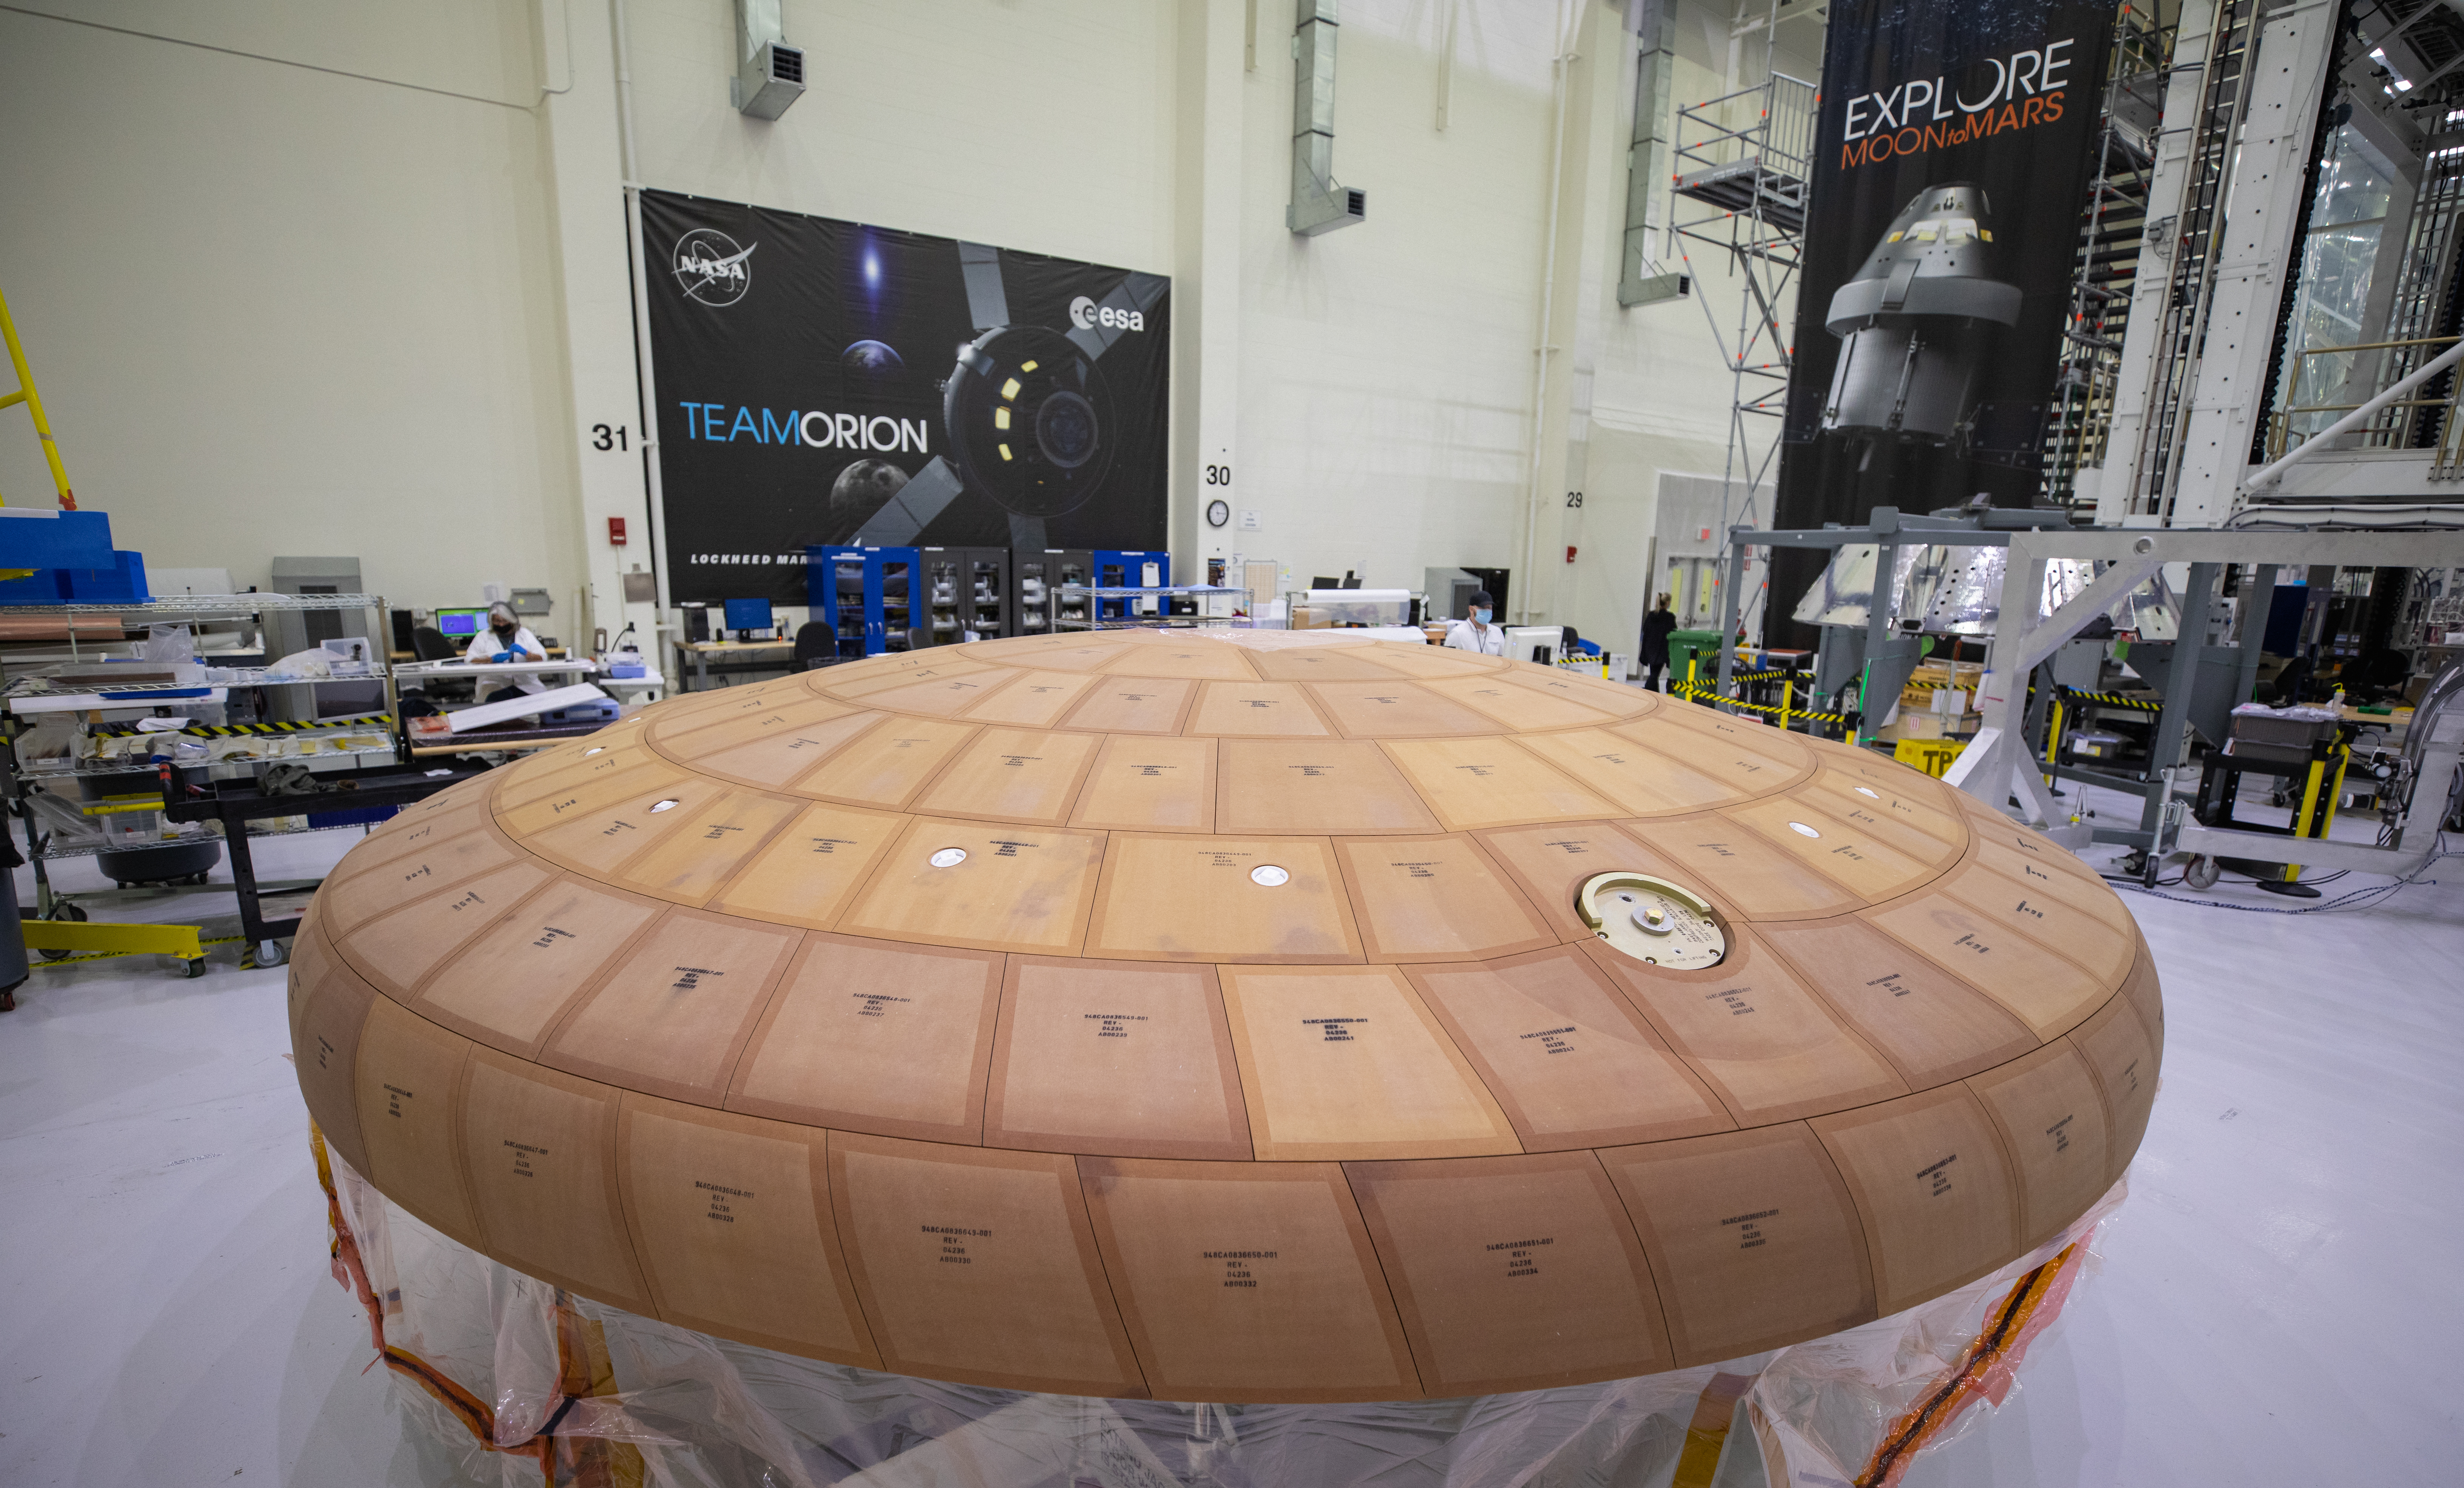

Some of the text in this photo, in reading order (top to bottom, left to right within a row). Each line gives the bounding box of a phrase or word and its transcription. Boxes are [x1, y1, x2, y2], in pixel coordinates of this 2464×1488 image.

[1844, 38, 2074, 141] EXPLORE
[681, 255, 746, 280] NASA
[1099, 306, 1144, 332] esa
[591, 423, 628, 451] 31
[1206, 465, 1230, 486] 30
[1567, 492, 1582, 508] 29
[690, 554, 808, 565] LOCKHEED MAR
[1923, 749, 1960, 777] TP
[1657, 901, 1677, 920] HEATSHIELD
[675, 966, 724, 976] 948CA0836547-001
[1866, 974, 1901, 986] 948CA0836553-001
[853, 993, 910, 1002] 948CA0836548-001
[1706, 987, 1752, 1000] 948CA0836552-001
[1520, 1027, 1576, 1039] 948CA0836551-001
[2057, 1135, 2066, 1144] 04236
[504, 1140, 548, 1155] 948CA0836647-001
[516, 1160, 529, 1168] 04236
[1917, 1154, 1957, 1179] 948CA0836653-001
[1933, 1171, 1942, 1179] REV
[1933, 1178, 1947, 1188] 04236
[695, 1181, 754, 1199] 948CA0836648-001
[711, 1203, 729, 1212] 04236
[708, 1212, 733, 1223] AB00328
[1720, 1209, 1779, 1226] 948CA0836652-001
[922, 1225, 991, 1237] 948CA0836649-001
[1742, 1231, 1761, 1239] 04236
[1486, 1238, 1553, 1251] 948CA0836651-001
[1740, 1239, 1766, 1249] AB00336
[1510, 1259, 1532, 1267] 04236
[1508, 1268, 1538, 1277] AB00334
